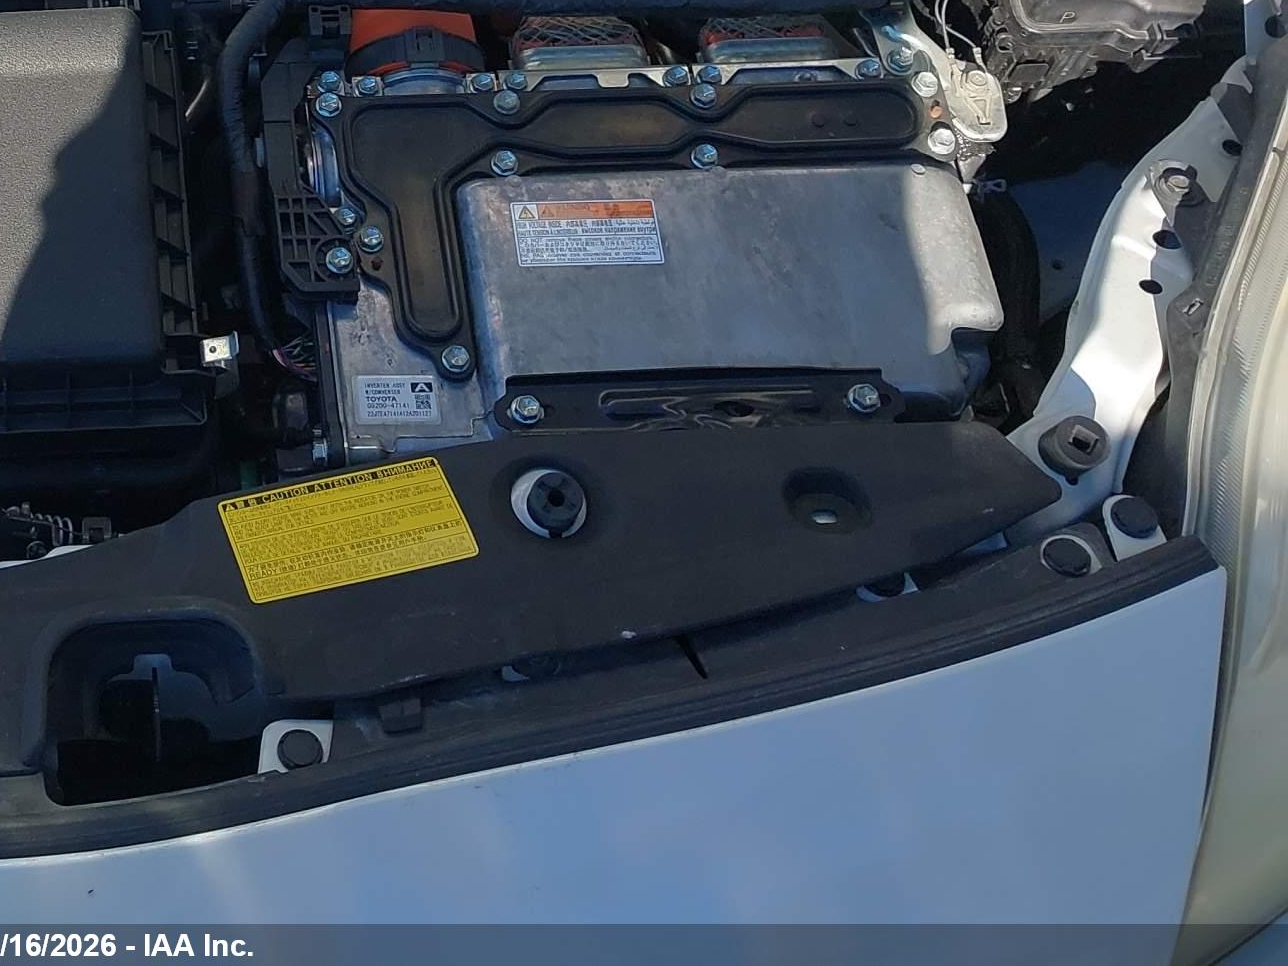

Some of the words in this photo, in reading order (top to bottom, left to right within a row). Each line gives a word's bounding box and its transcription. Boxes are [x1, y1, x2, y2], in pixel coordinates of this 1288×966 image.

[262, 485, 309, 504] CAUTION
[314, 472, 373, 493] ATTENTION
[377, 459, 434, 480] ВНИМАНИЕ
